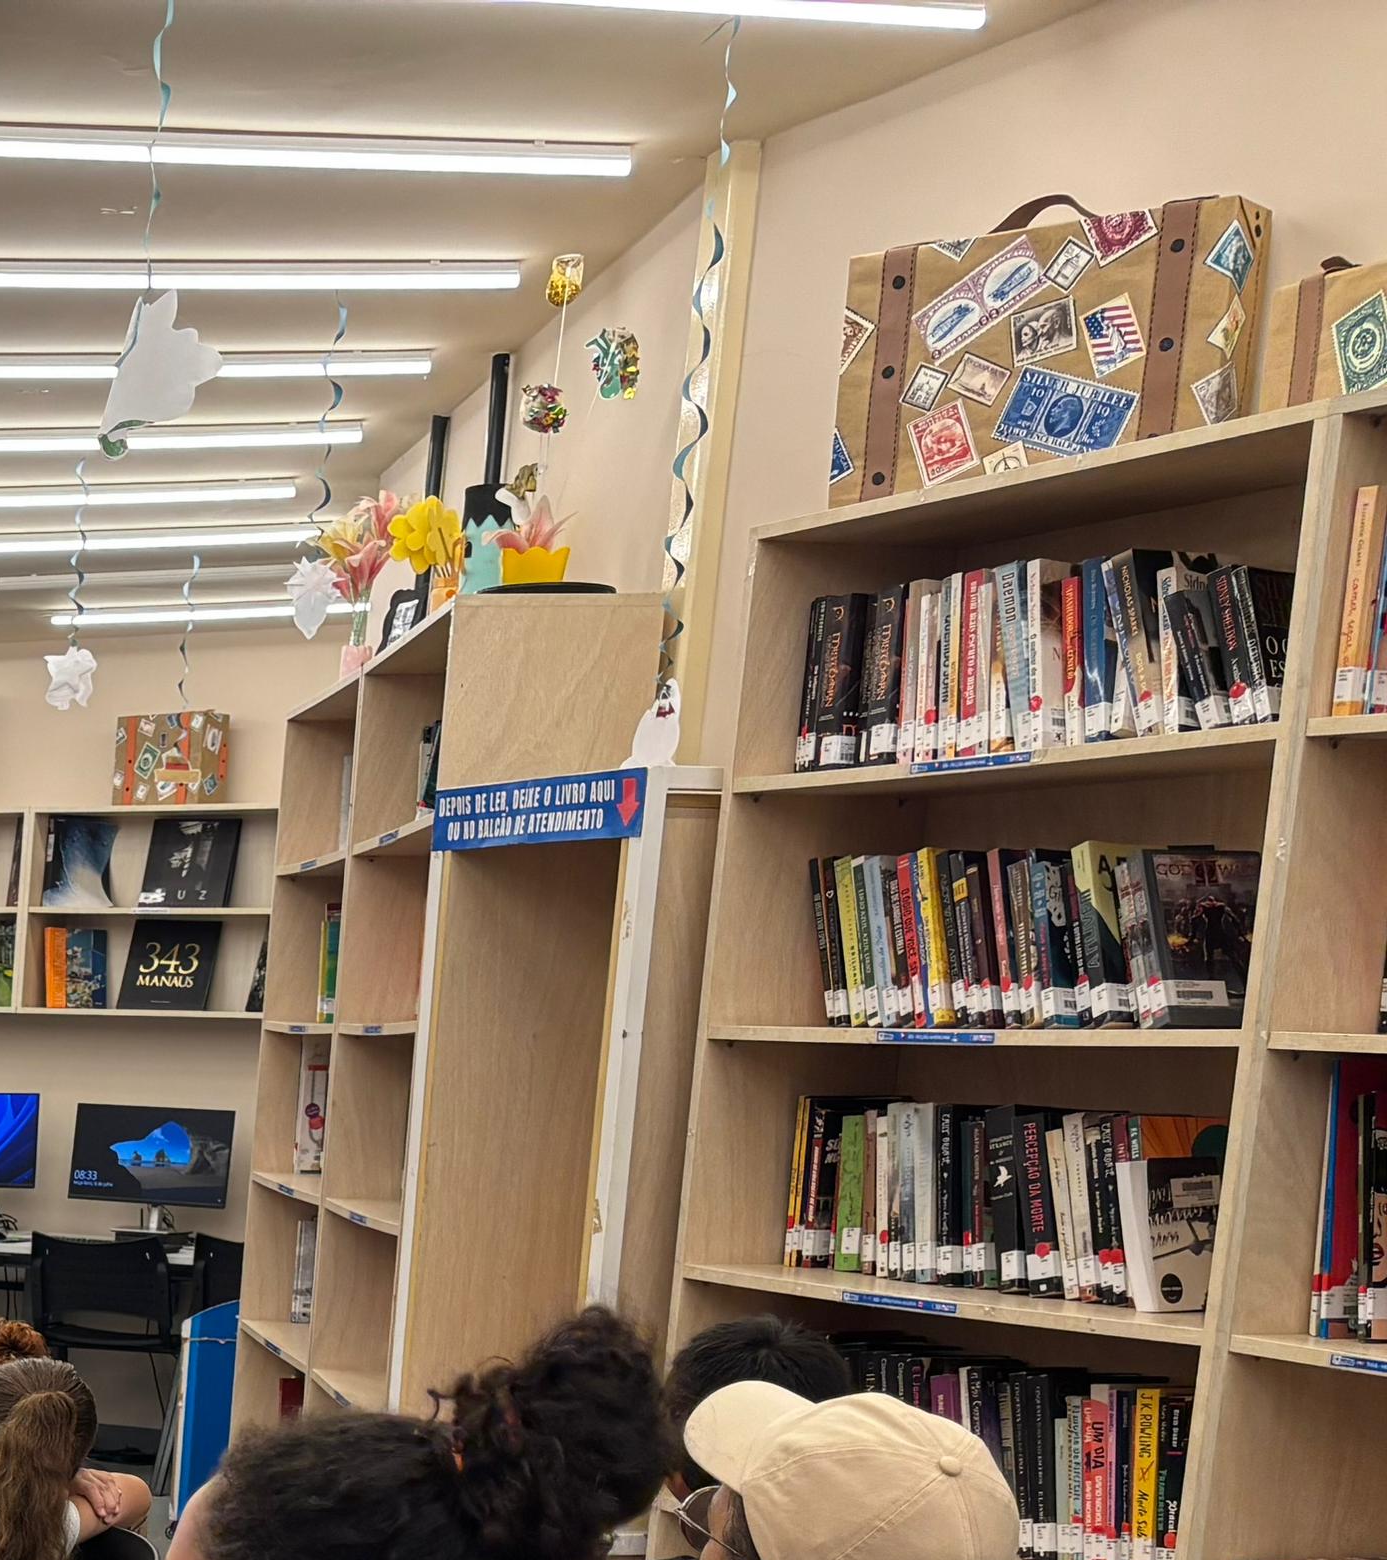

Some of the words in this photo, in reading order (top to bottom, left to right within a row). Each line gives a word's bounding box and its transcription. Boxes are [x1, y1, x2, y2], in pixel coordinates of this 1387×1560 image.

[1023, 372, 1072, 392] SILVER
[1073, 385, 1131, 409] JUBILEE
[1002, 572, 1018, 623] Daemon
[1121, 566, 1133, 608] NICHOLAS
[1215, 575, 1230, 607] SIDNEY
[1221, 608, 1238, 651] SHELDON
[439, 796, 471, 817] DEPOIS
[475, 793, 487, 814] DE
[489, 791, 510, 813] LER,
[513, 787, 541, 810] DEIXE
[544, 785, 552, 806] O
[555, 783, 586, 805] LIVRO
[590, 779, 615, 802] AQUI
[447, 820, 460, 841] OU
[463, 819, 475, 840] NO
[478, 813, 511, 838] BALCÃO
[513, 815, 525, 835] DE
[527, 808, 604, 834] ATENDIMENTO
[139, 942, 201, 976] 343
[136, 975, 194, 988] MANAUS
[1023, 1122, 1041, 1179] PERCEPÇÃO
[74, 1169, 98, 1181] 08:33
[1028, 1184, 1041, 1197] DA
[1030, 1199, 1044, 1233] MORTE
[1091, 1421, 1104, 1443] UM
[1138, 1414, 1154, 1458] ROWLING
[1092, 1447, 1105, 1470] DIA
